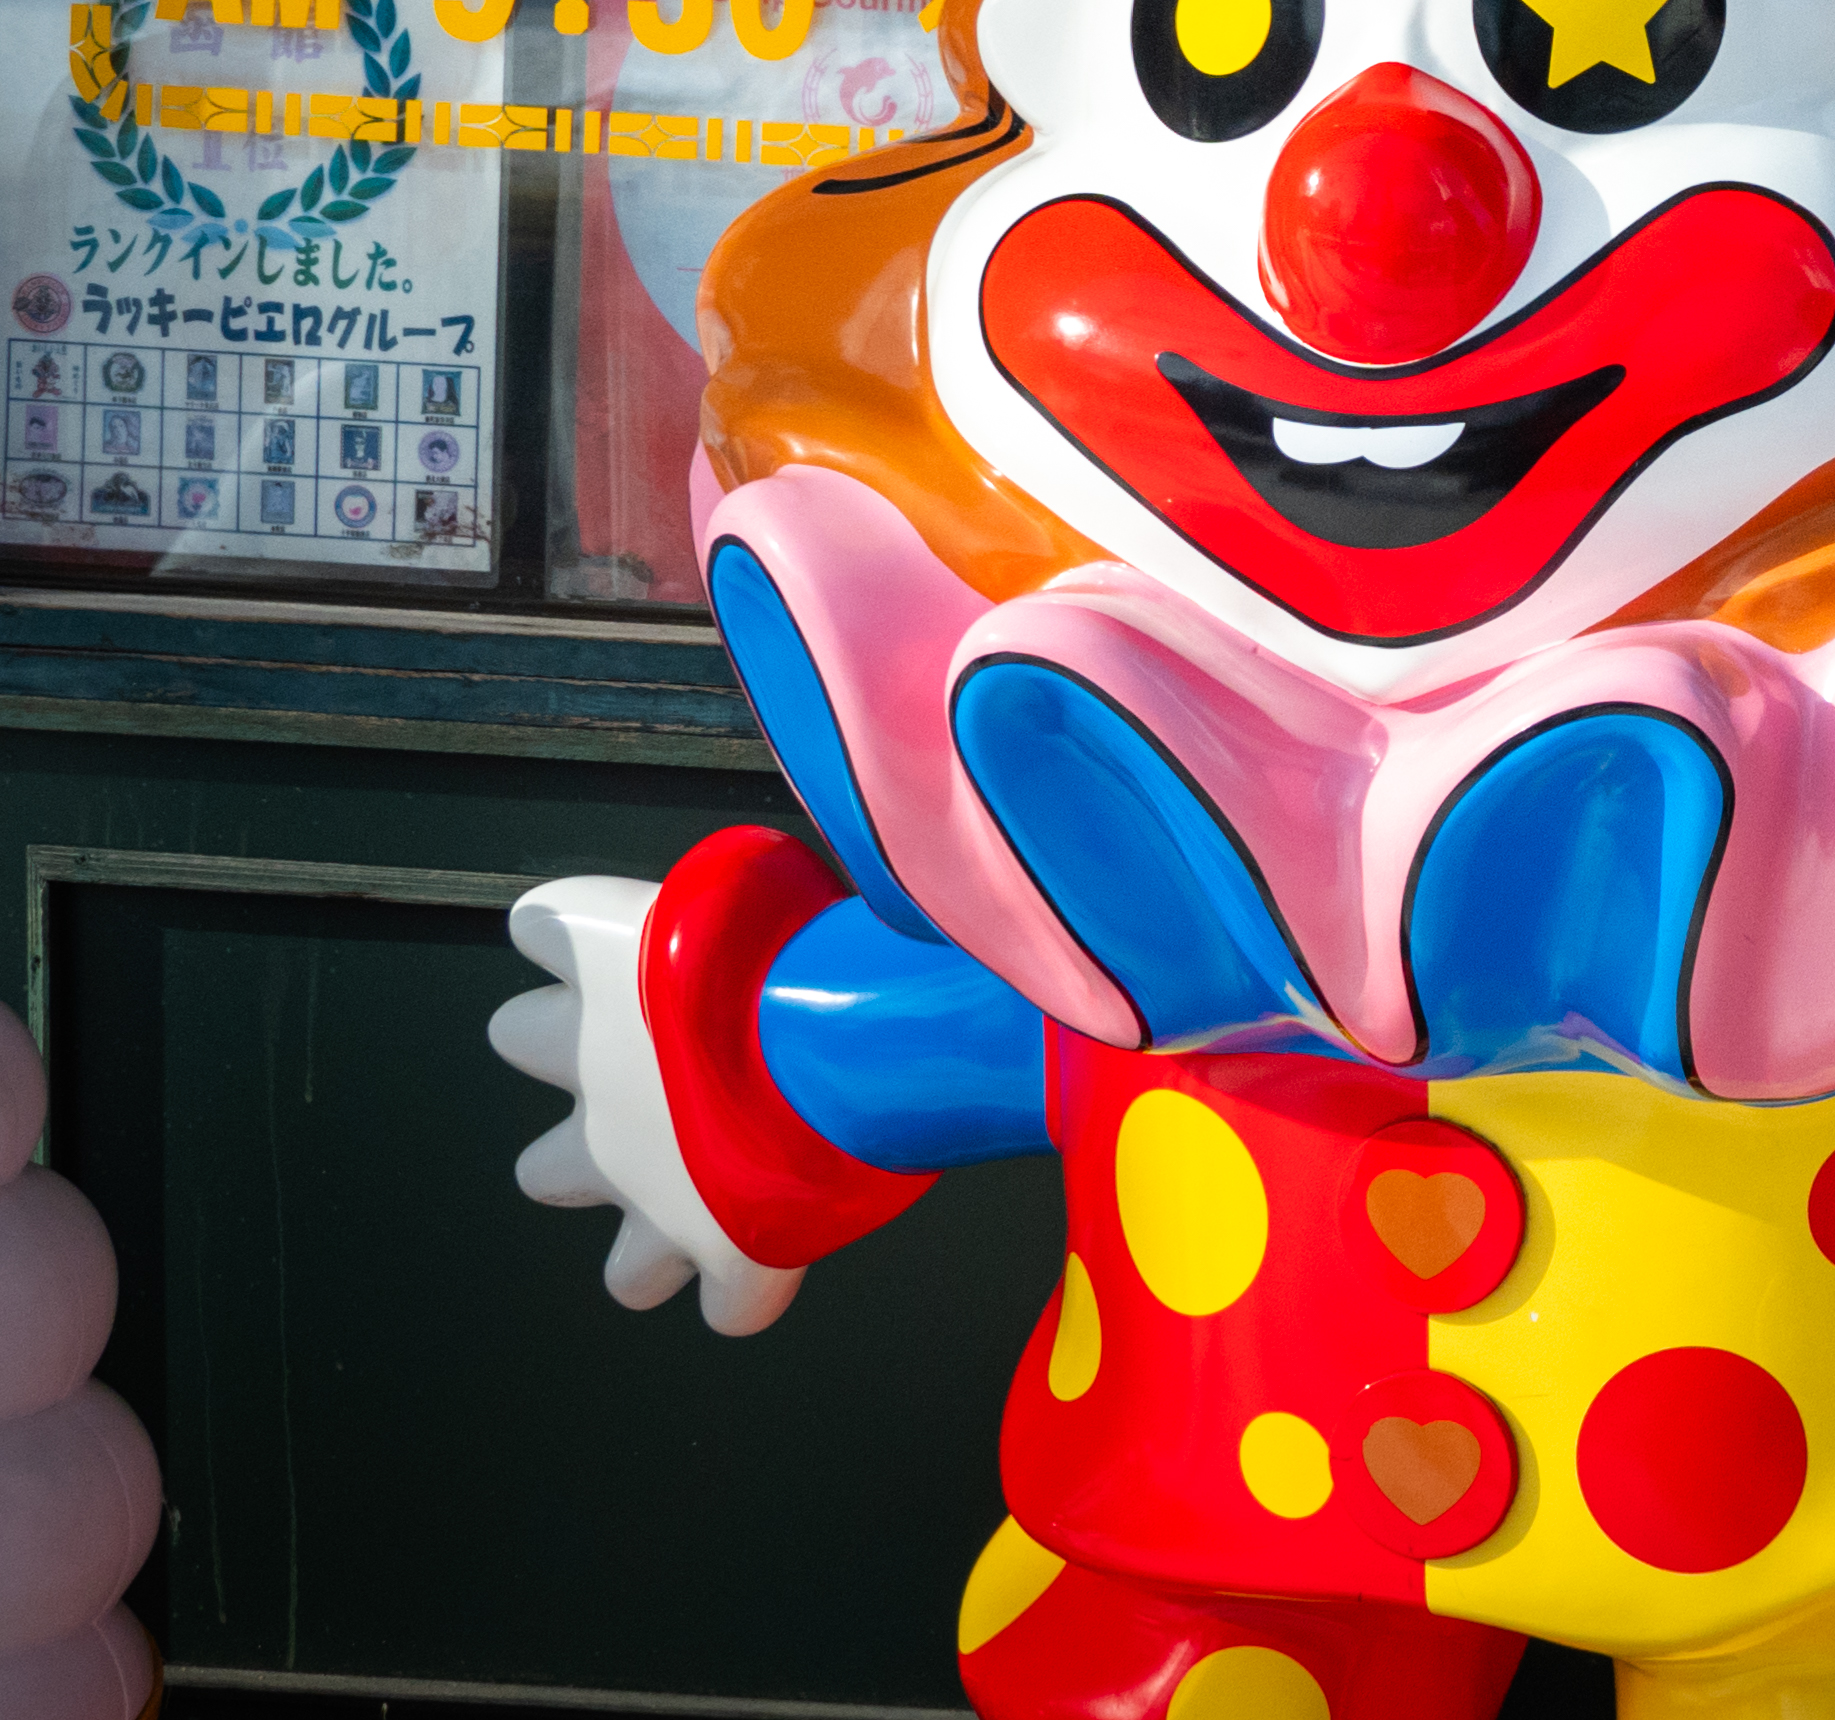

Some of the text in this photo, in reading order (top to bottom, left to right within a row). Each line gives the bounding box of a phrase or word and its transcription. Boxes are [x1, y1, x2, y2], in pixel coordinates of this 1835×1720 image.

[70, 224, 413, 294] ランクインしました。
[83, 283, 476, 356] ラッキーピエログループ
